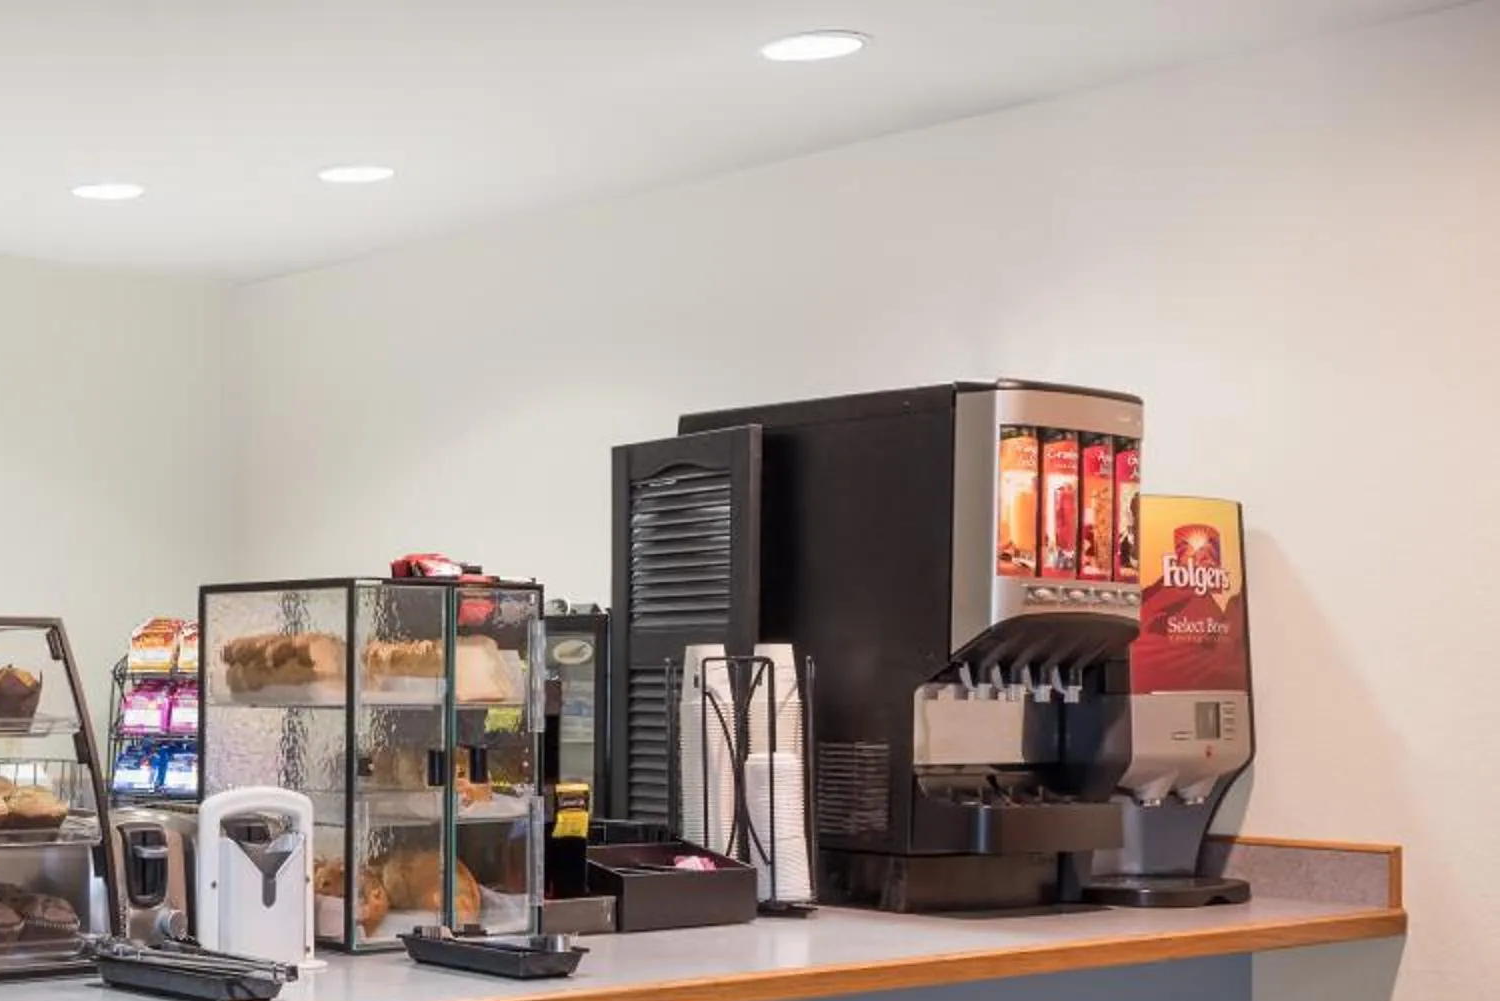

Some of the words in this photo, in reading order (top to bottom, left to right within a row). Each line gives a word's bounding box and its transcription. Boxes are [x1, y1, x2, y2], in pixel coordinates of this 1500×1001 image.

[1162, 552, 1230, 596] Folgers
[1167, 615, 1204, 634] Select
[1207, 617, 1229, 634] Brew
